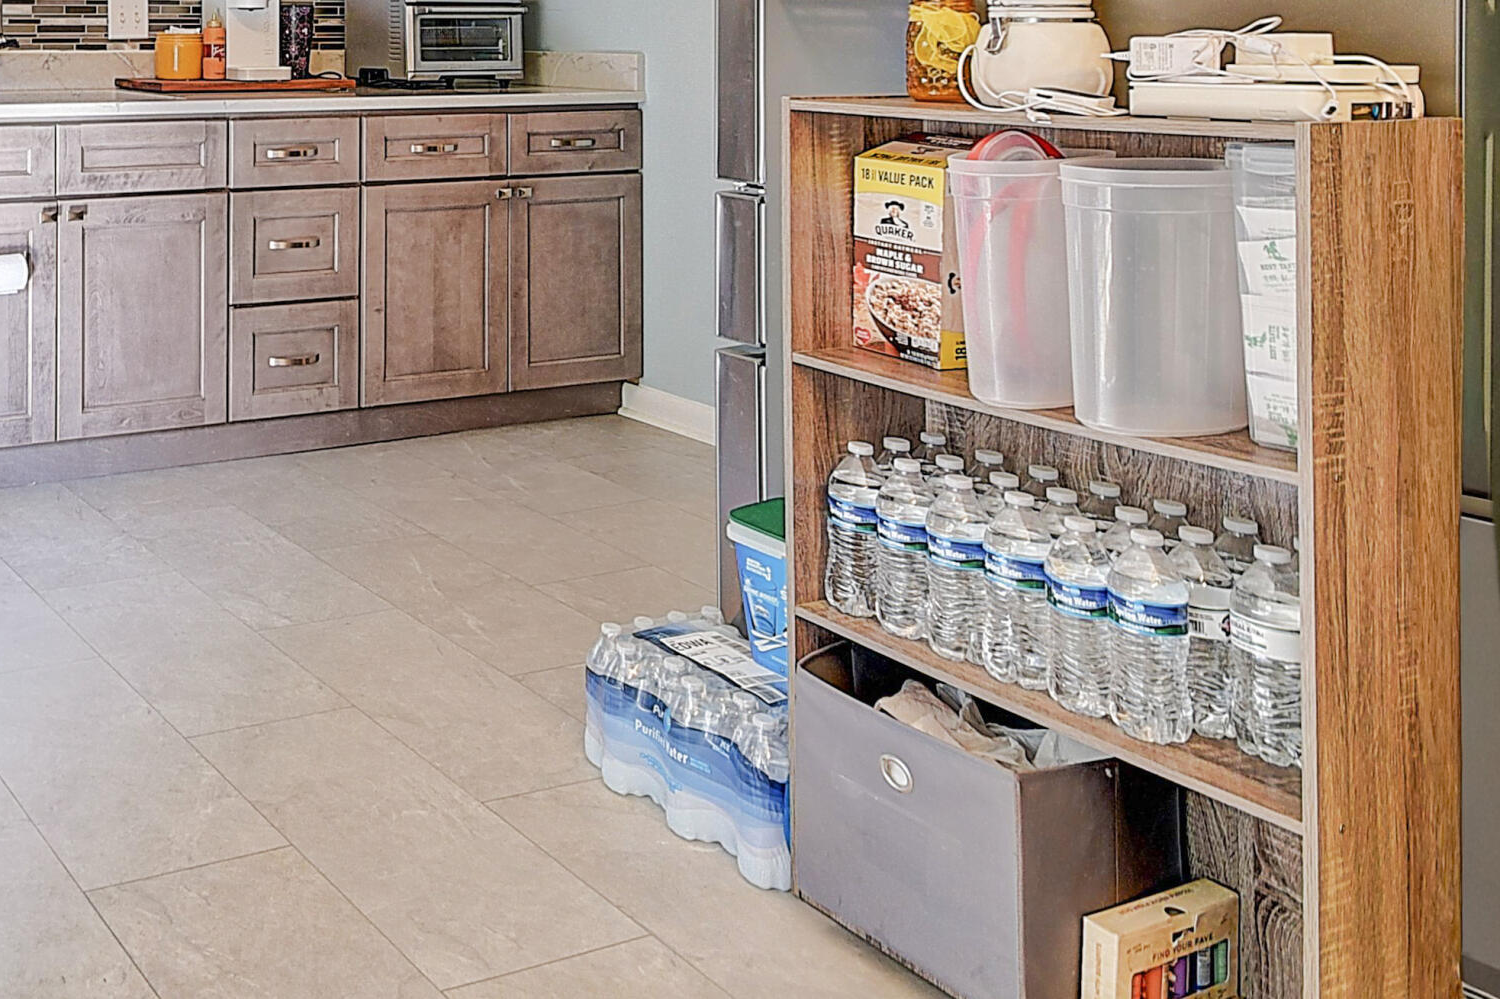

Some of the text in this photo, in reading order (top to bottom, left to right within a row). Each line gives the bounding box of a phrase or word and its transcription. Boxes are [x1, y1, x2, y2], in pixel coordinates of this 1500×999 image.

[861, 168, 934, 189] 18 VALUE PACK
[875, 225, 914, 242] QUAKER
[876, 247, 904, 261] MAPLE
[866, 254, 895, 268] BROWN
[895, 260, 924, 274] SUGAR
[1074, 596, 1097, 608] Water
[1137, 611, 1162, 624] Water
[1152, 948, 1170, 962] FIND
[1173, 940, 1193, 953] YOUR
[1195, 932, 1213, 946] FAVE
